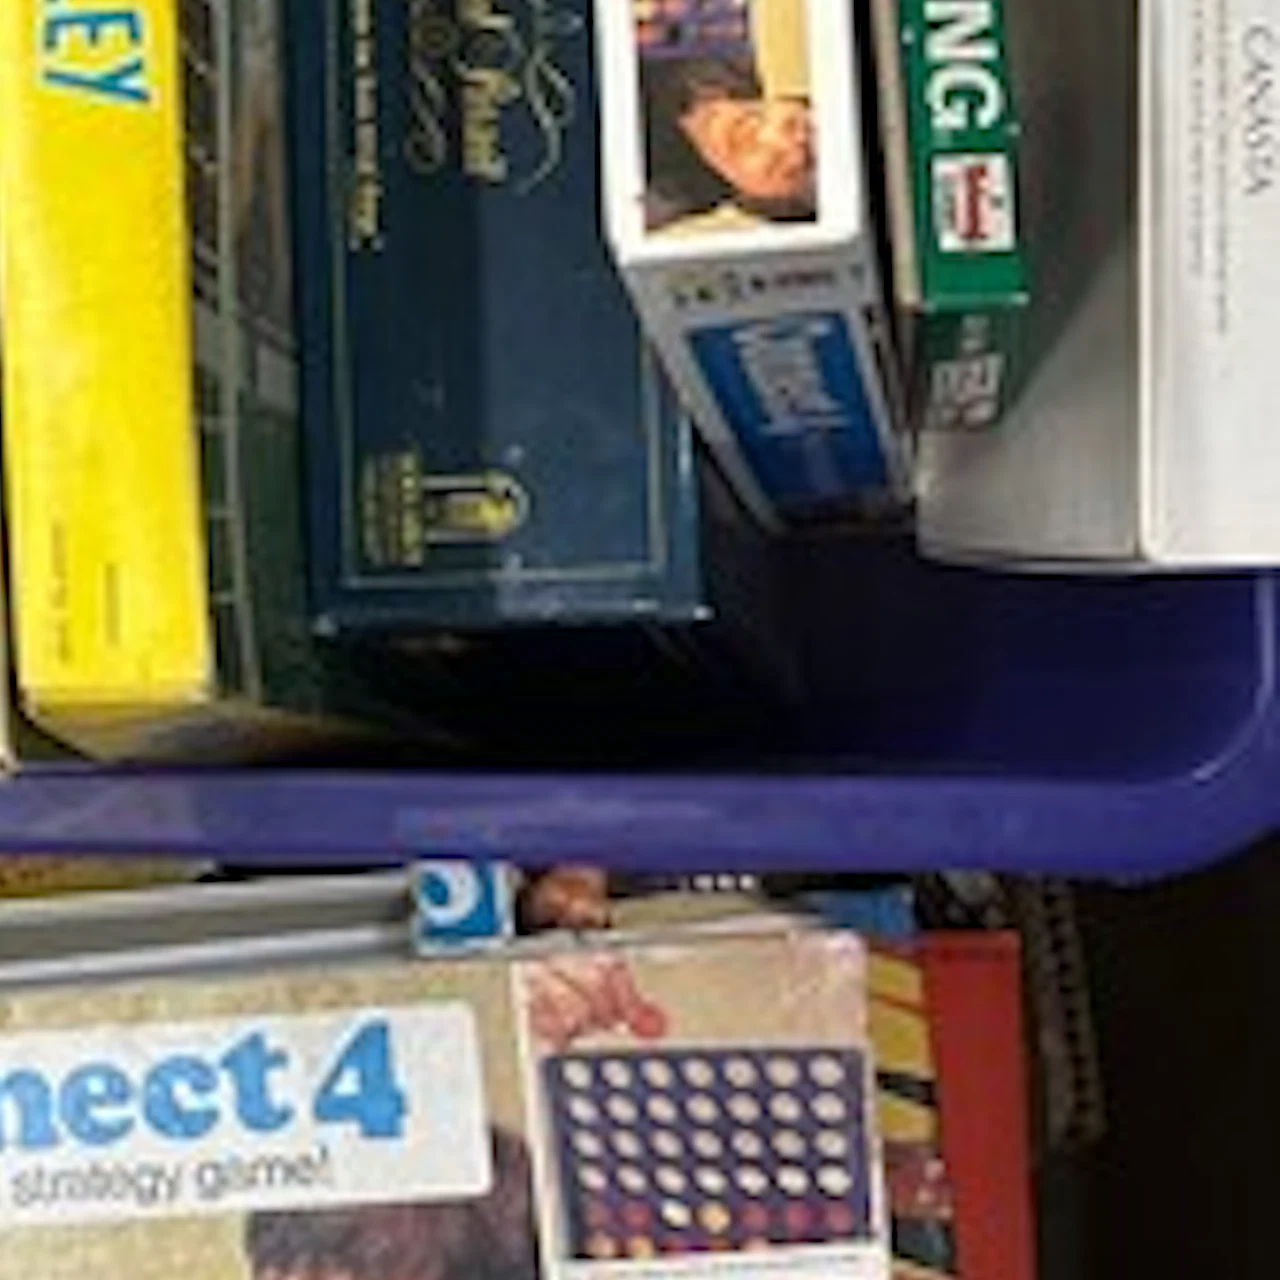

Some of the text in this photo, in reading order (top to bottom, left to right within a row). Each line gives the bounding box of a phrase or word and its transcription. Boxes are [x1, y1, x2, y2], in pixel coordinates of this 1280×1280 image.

[1242, 24, 1277, 199] CANASTA
[313, 1017, 408, 1141] 4
[11, 1154, 183, 1213] strategy
[195, 1144, 332, 1200] game!
